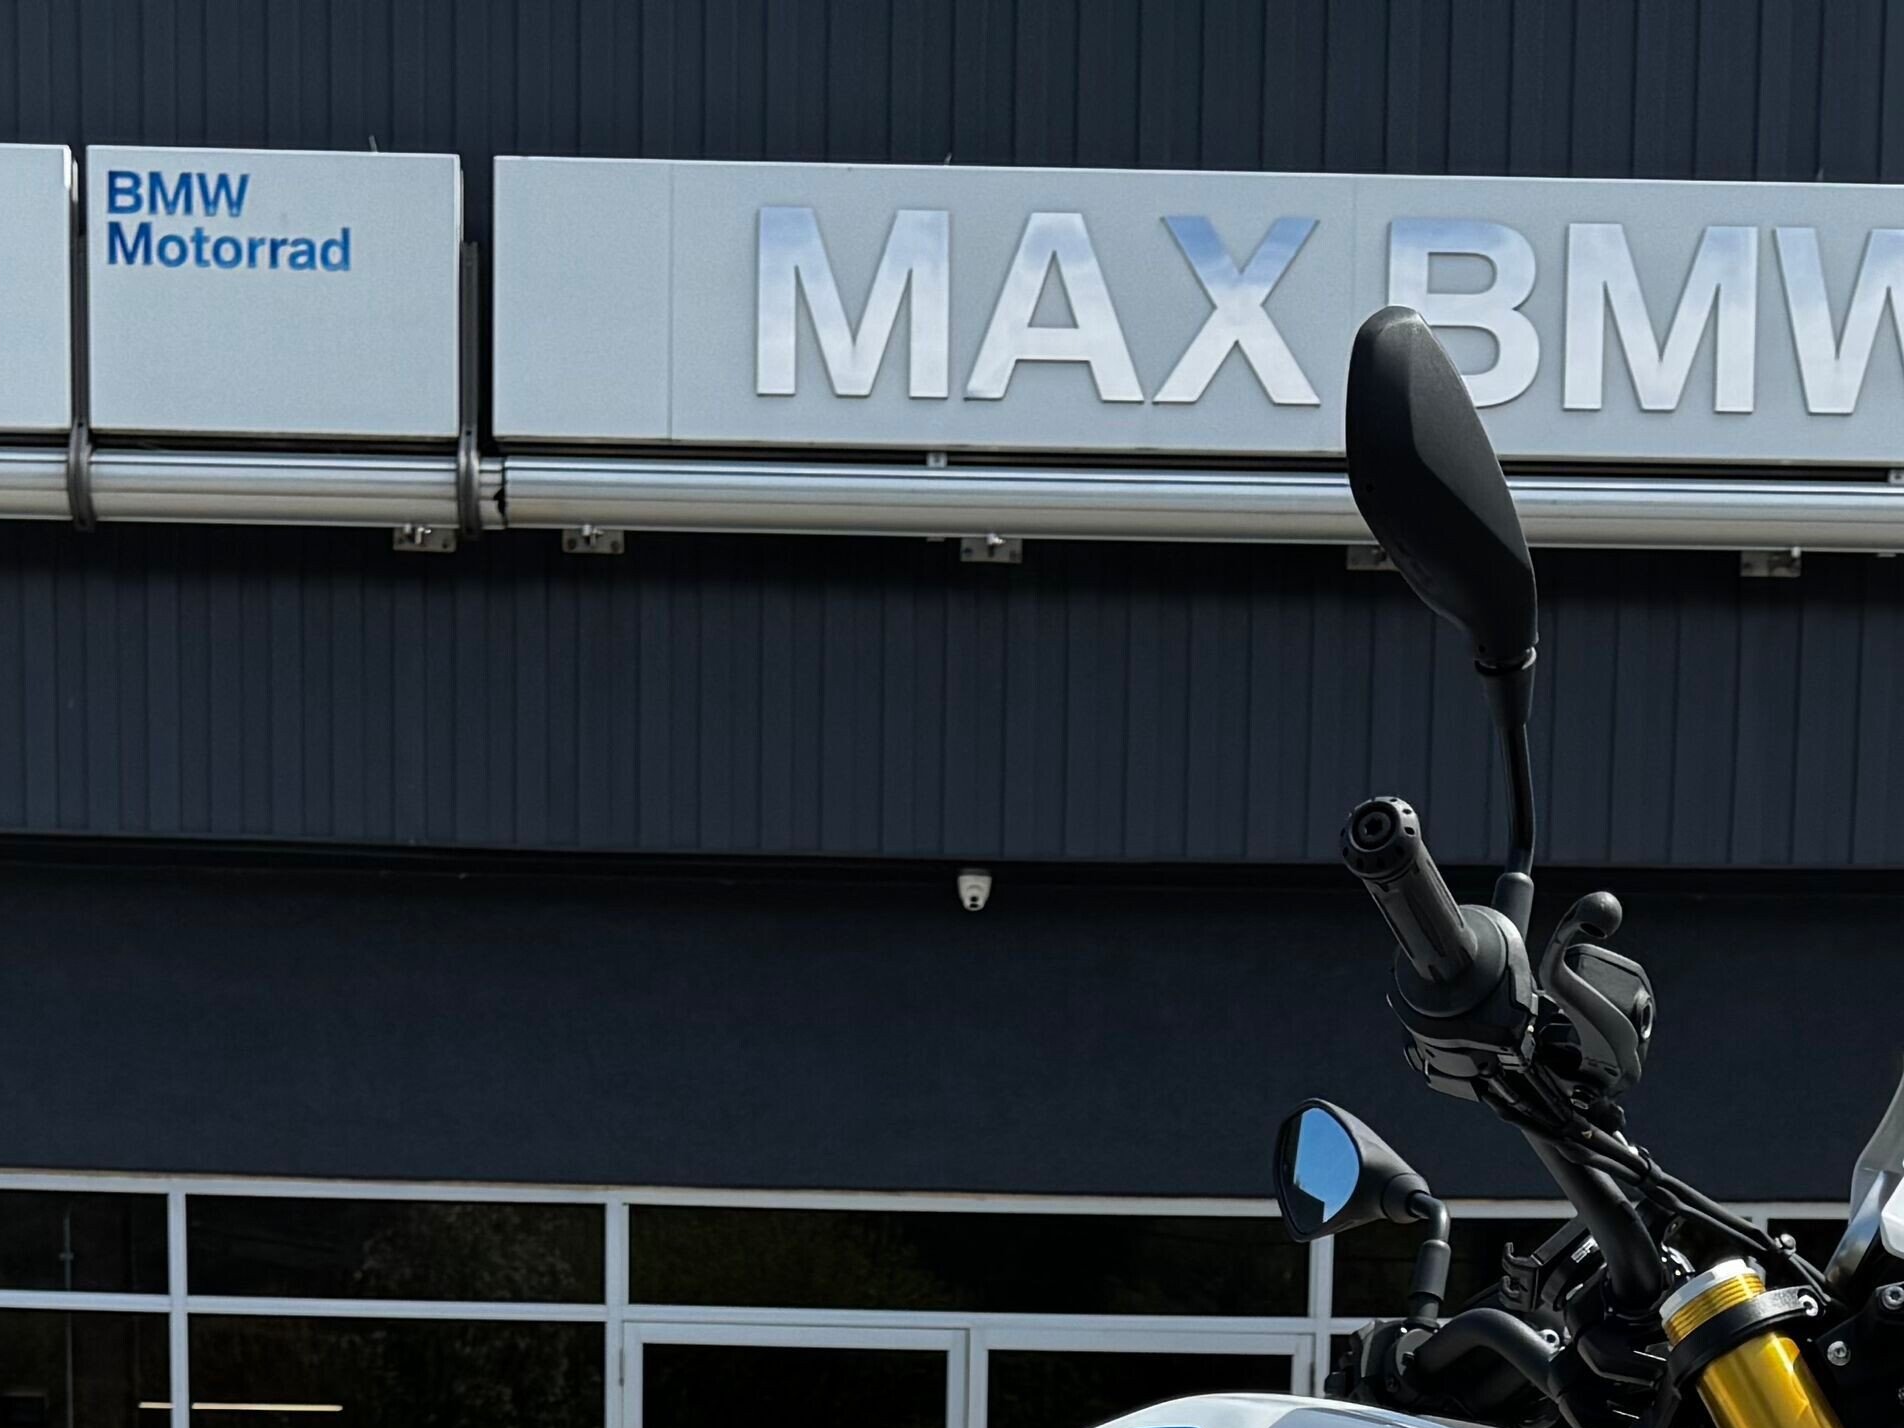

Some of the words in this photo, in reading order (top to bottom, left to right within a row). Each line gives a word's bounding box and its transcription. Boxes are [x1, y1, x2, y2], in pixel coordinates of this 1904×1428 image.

[106, 170, 249, 218] BMW
[107, 222, 351, 272] Motorrad
[753, 205, 1322, 407] MAX
